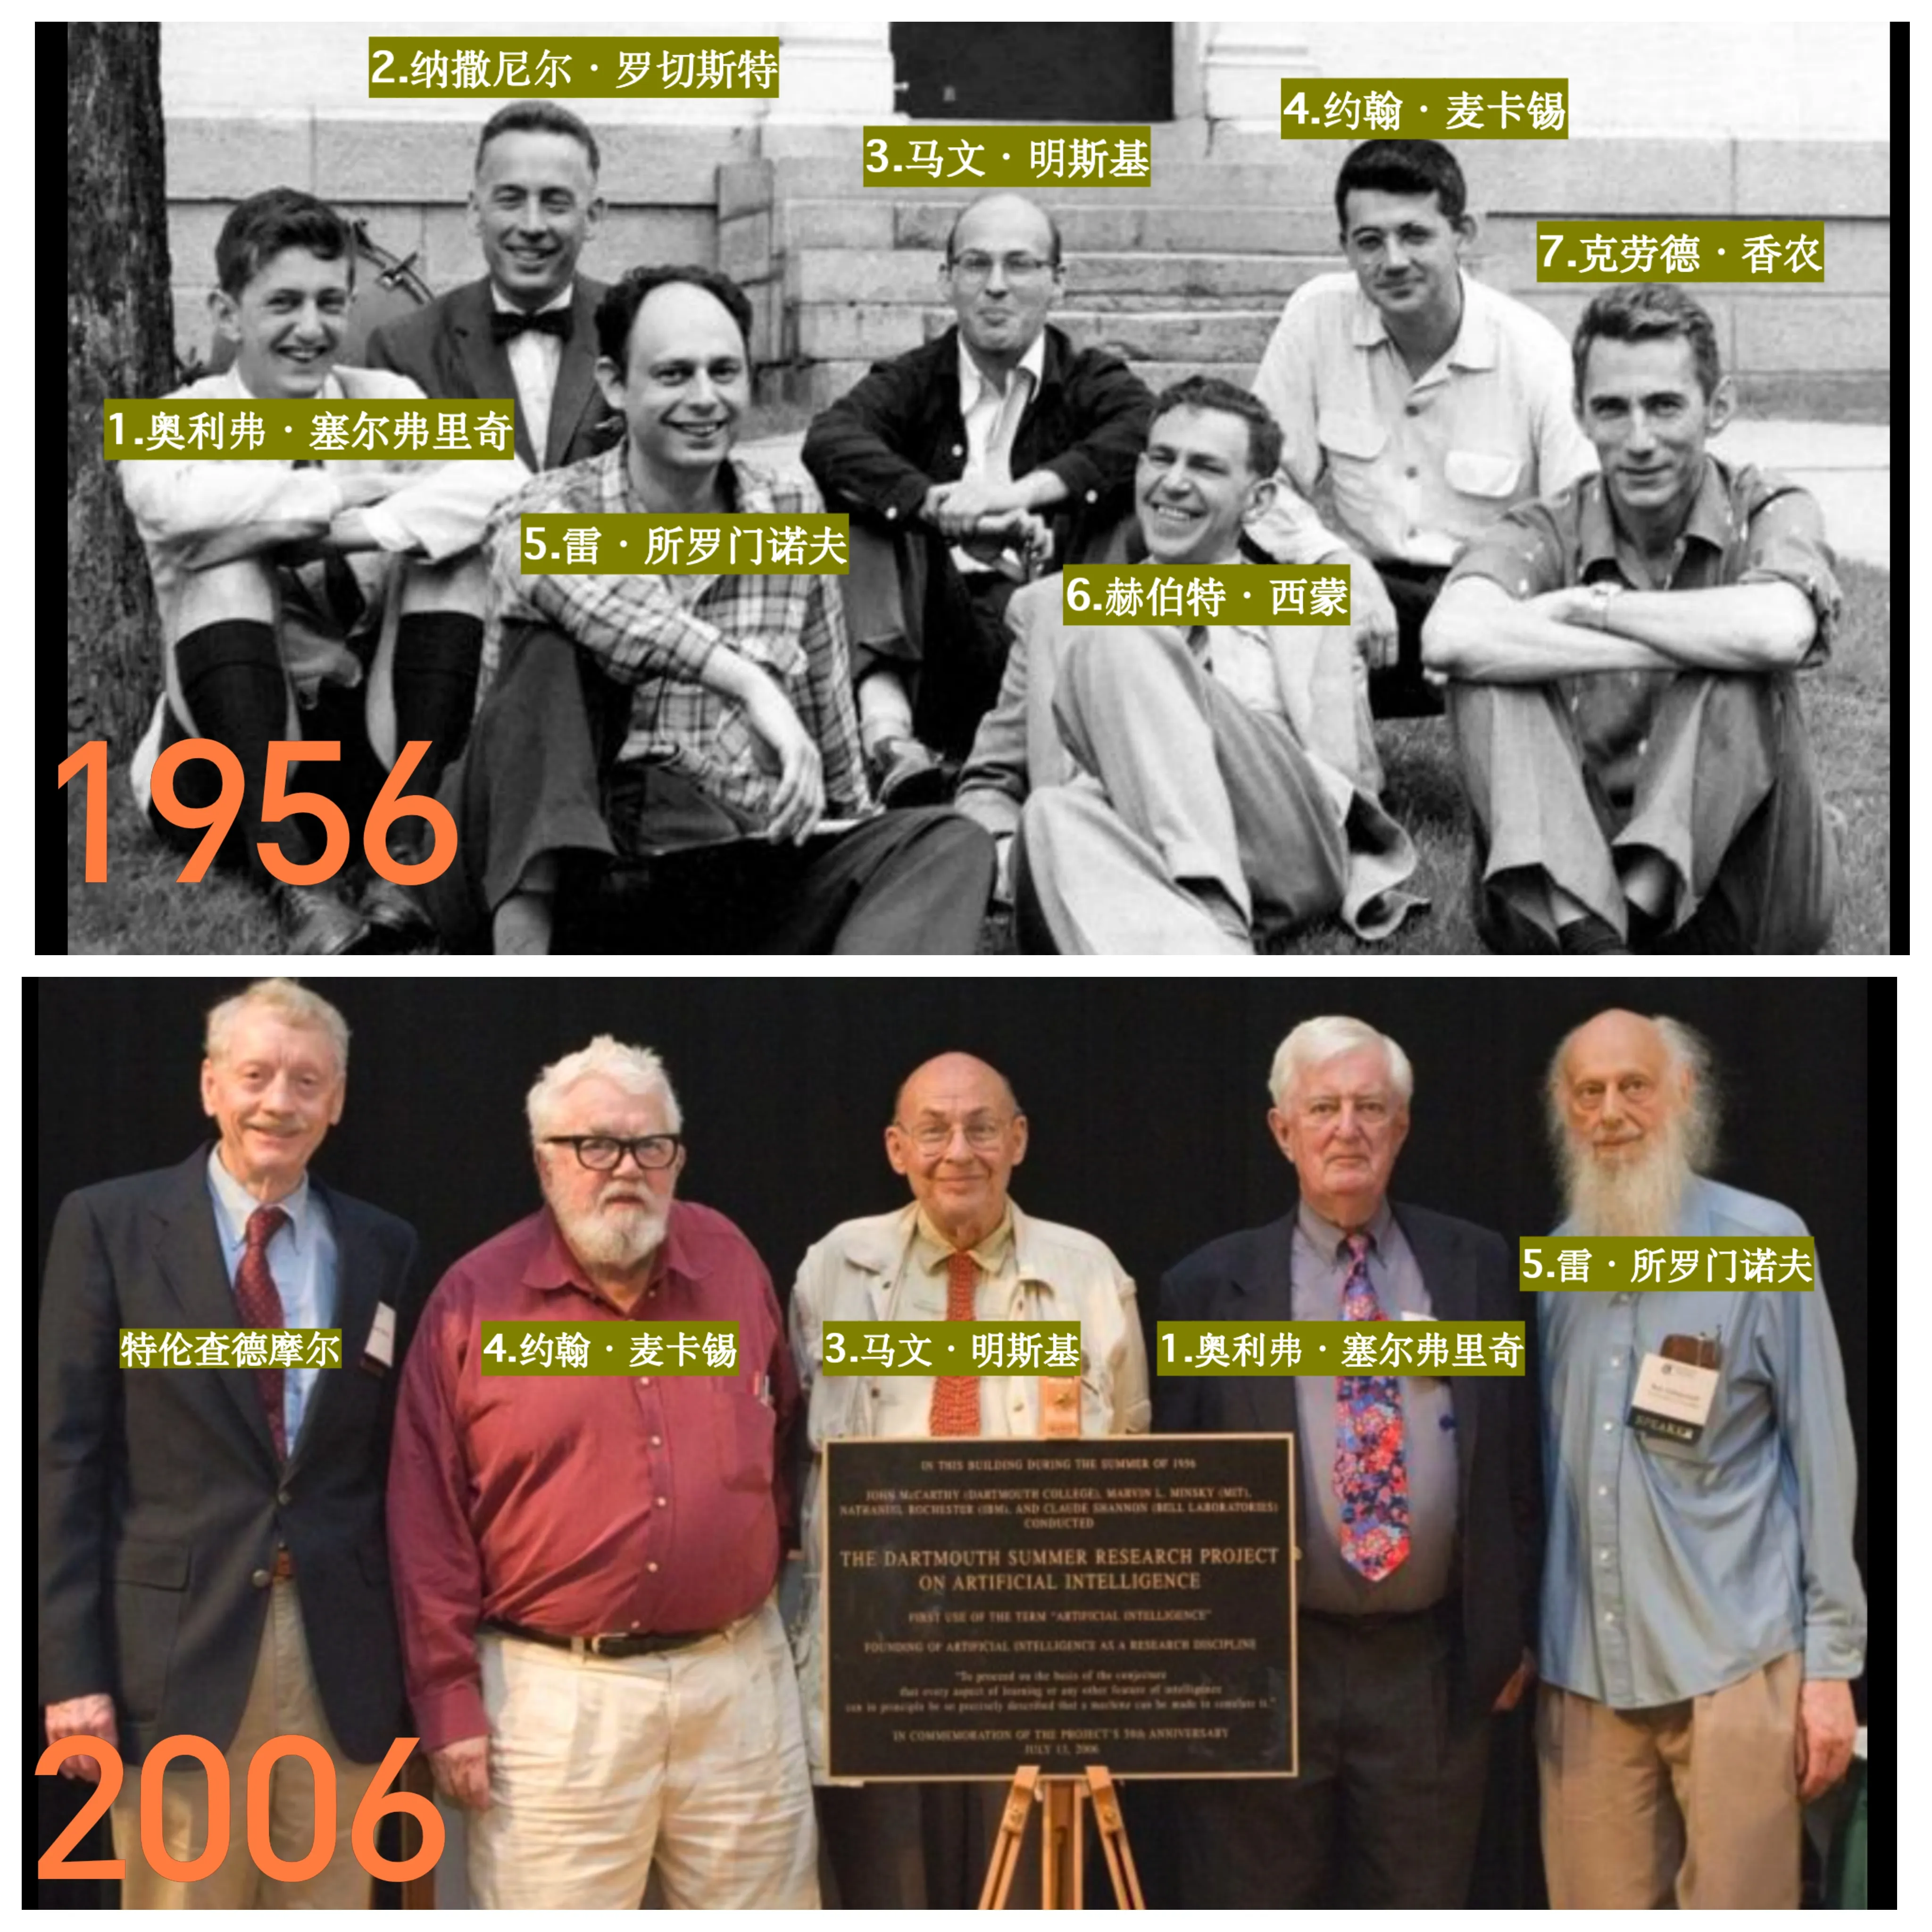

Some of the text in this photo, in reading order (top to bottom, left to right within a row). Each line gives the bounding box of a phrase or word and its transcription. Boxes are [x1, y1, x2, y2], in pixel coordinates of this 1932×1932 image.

[840, 1548, 1279, 1567] THE DARTMOUTH SUMMER RESEARCH PROJECT
[918, 1573, 1200, 1591] ON ARTIFICIAL INTELLIGENCE
